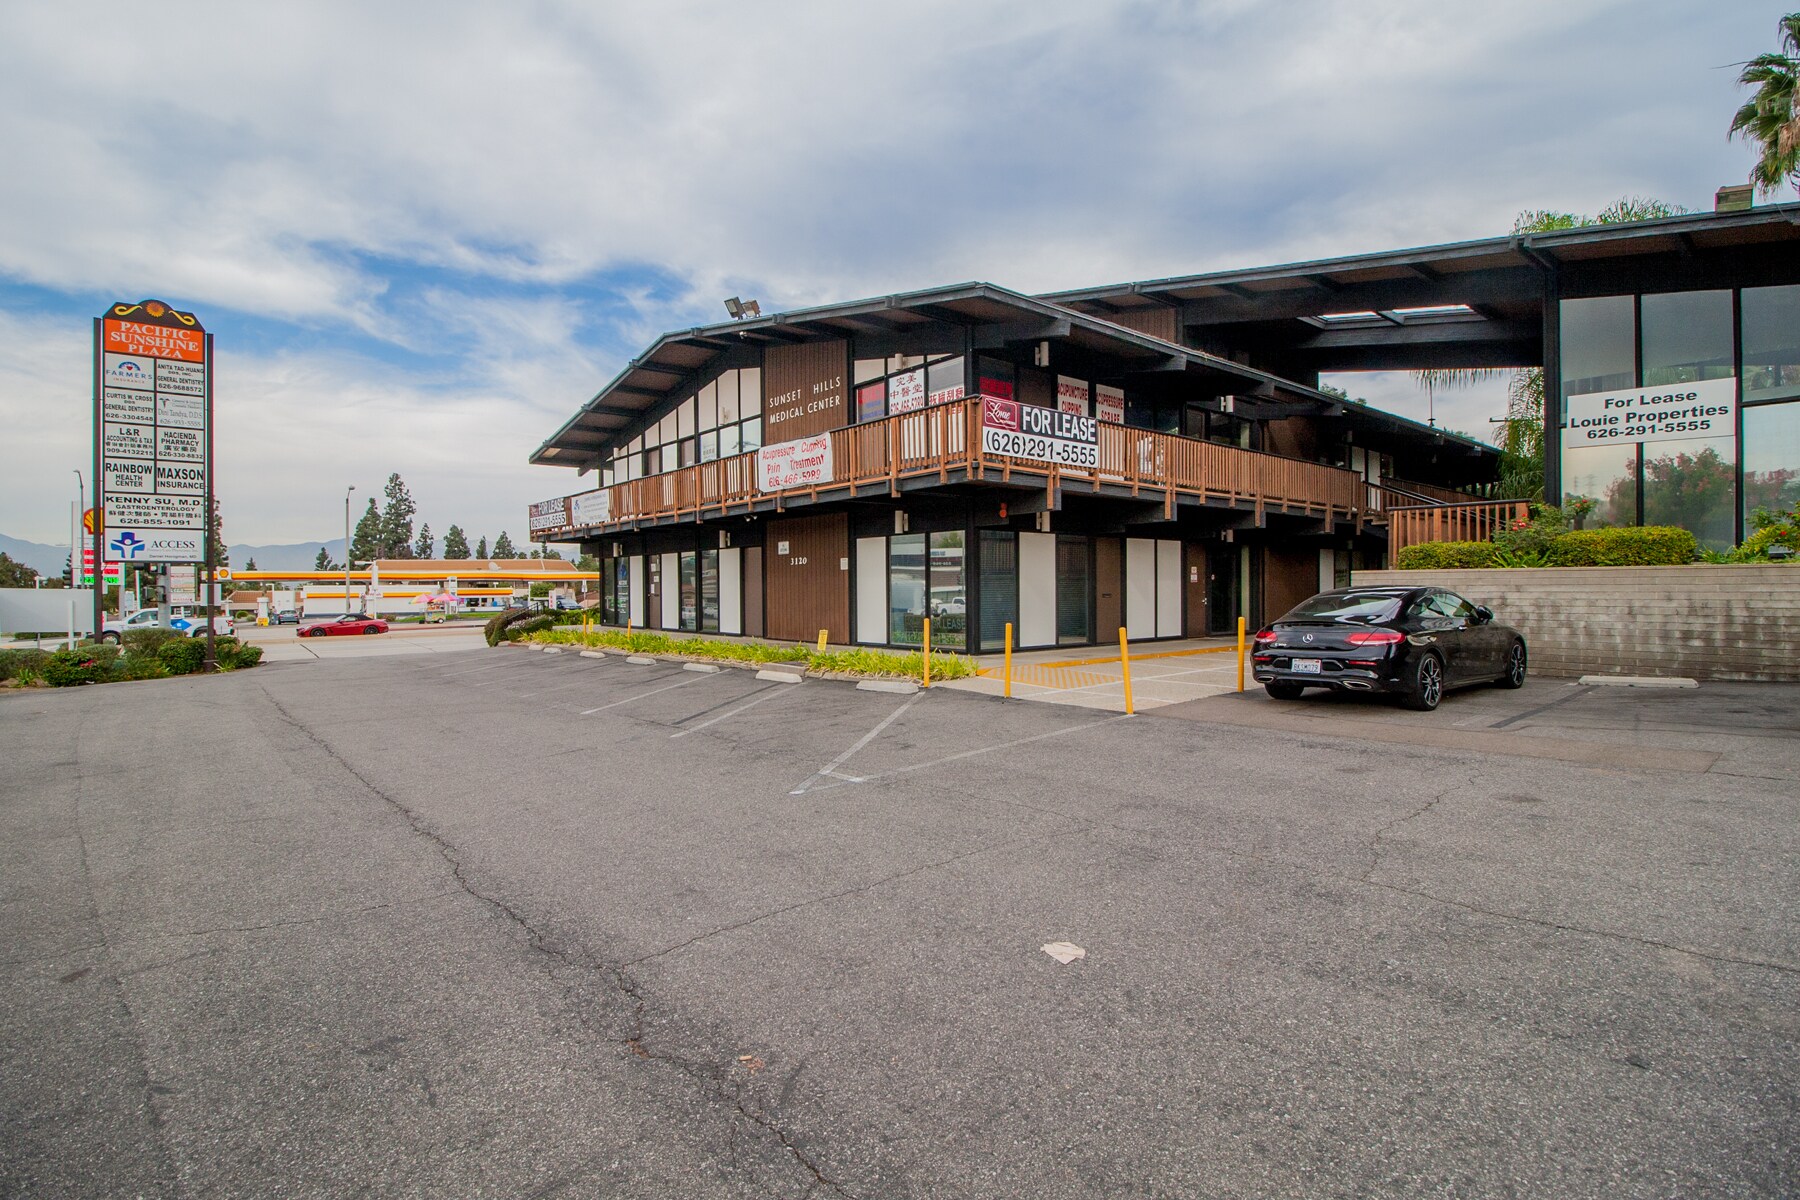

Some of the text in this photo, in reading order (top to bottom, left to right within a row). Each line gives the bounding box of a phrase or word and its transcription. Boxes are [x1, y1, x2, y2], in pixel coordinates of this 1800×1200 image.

[120, 322, 190, 340] PACIFIC
[110, 332, 199, 352] SUNSHINE
[128, 344, 183, 358] PLAZA
[106, 370, 152, 379] FARMERS
[158, 376, 178, 384] GENERAL
[770, 389, 801, 408] SUNSET
[813, 376, 841, 394] HILLS
[890, 383, 922, 399] 中醫堂
[1058, 383, 1088, 401] ACUPUNCTURE
[1096, 393, 1123, 410] ACUPRESSURE
[1604, 392, 1697, 409] For Lease
[128, 405, 154, 413] DENTISTRY
[770, 395, 840, 424] MEDICAL CENTER
[1062, 401, 1081, 416] CUPPING
[1571, 405, 1729, 428] Louie Properties
[1022, 406, 1096, 442] FOR LEASE
[1587, 420, 1711, 439] 626-291-5555
[107, 435, 137, 443] ACCOUNTING
[120, 428, 140, 436] L&R
[164, 432, 196, 440] HACIENDA
[161, 438, 199, 446] PHARMACY
[986, 430, 1096, 465] (626)291-5555
[762, 446, 795, 460] Acupressure
[106, 463, 153, 474] RAINBOW
[790, 453, 825, 470] Treatment
[158, 467, 204, 480] MAXSON
[158, 481, 204, 489] INSURANCE
[106, 496, 150, 504] KENNY
[155, 498, 175, 506] SU,
[116, 504, 196, 512] GASTROENTEROLOGY
[538, 502, 548, 515] FOR
[549, 498, 564, 513] LEASE
[151, 540, 195, 548] ACCESS
[790, 557, 807, 565] 3120
